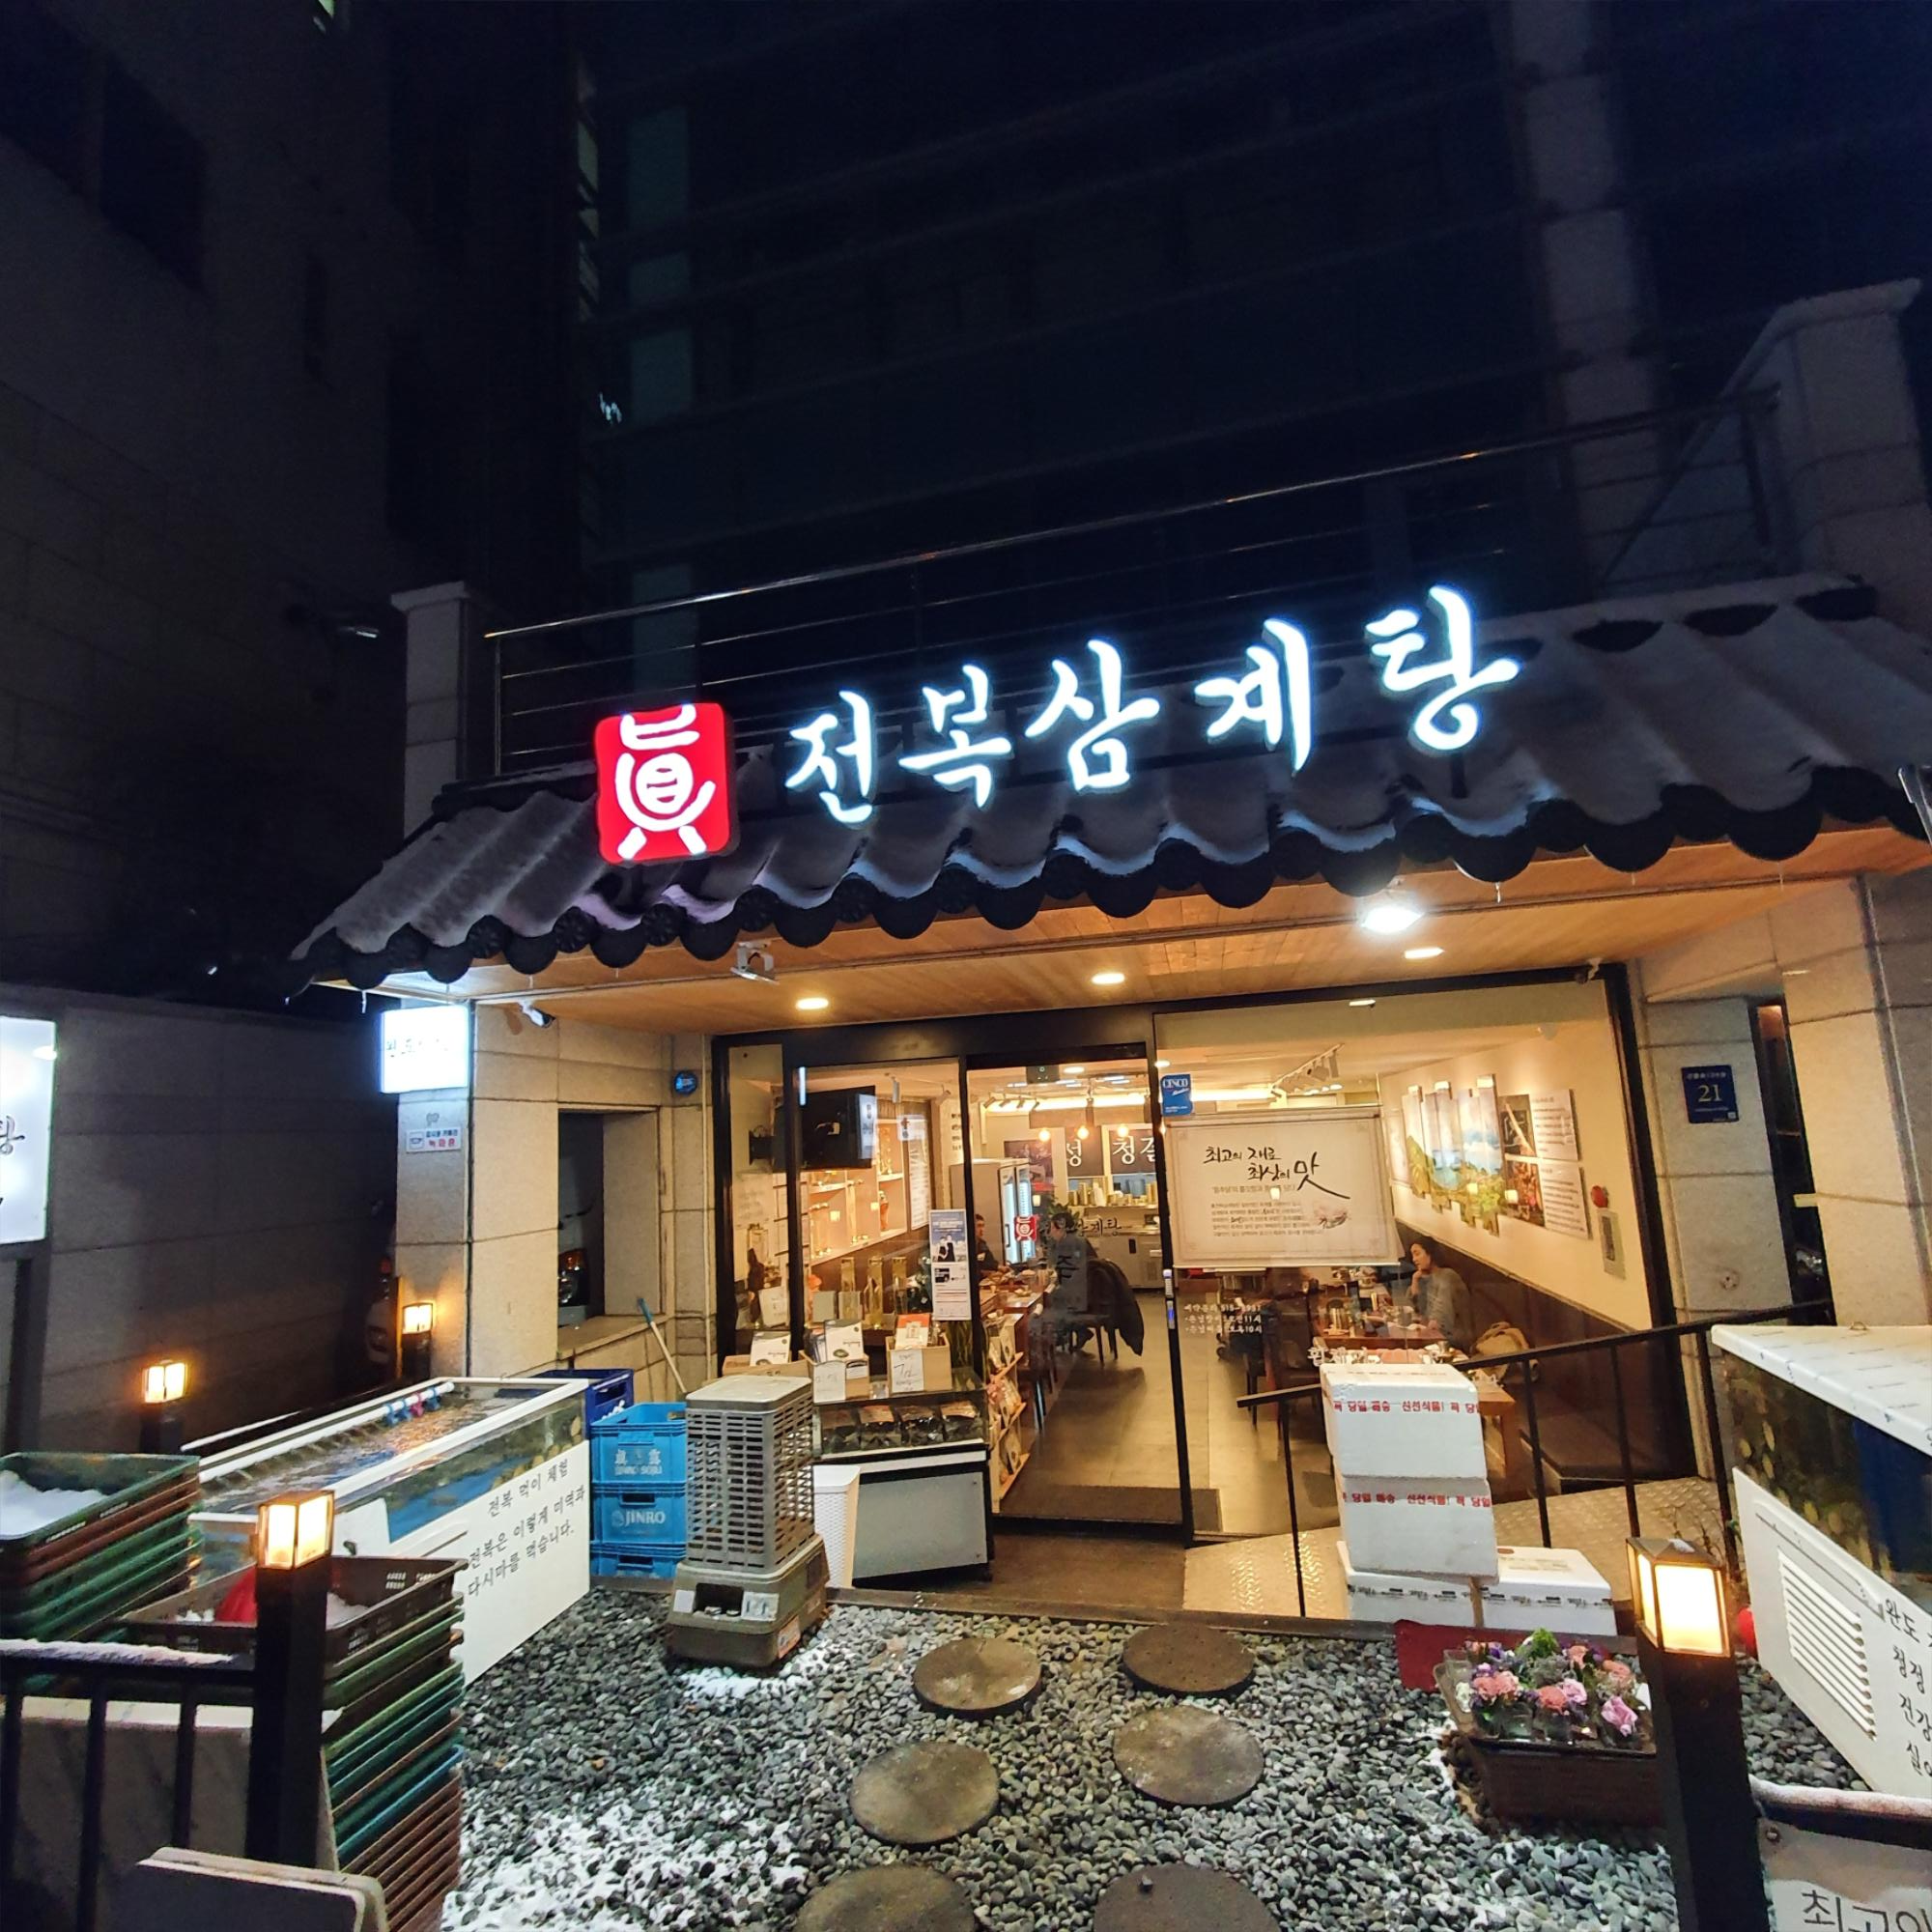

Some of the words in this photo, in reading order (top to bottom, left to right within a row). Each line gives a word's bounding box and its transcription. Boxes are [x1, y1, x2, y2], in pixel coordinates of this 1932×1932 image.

[784, 583, 1523, 826] 전복삼계탕
[1698, 1083, 1723, 1102] 21
[1204, 1146, 1242, 1164] 최고의
[1247, 1146, 1283, 1160] 재료
[1293, 1151, 1350, 1200] 맛
[1465, 1403, 1480, 1414] 당
[488, 1490, 514, 1518] 전복
[624, 1510, 666, 1526] JINRO
[469, 1532, 509, 1570] 전복은
[468, 1551, 521, 1597] 다시마를
[1886, 1599, 1920, 1643] 완도
[1893, 1644, 1925, 1694] 청정
